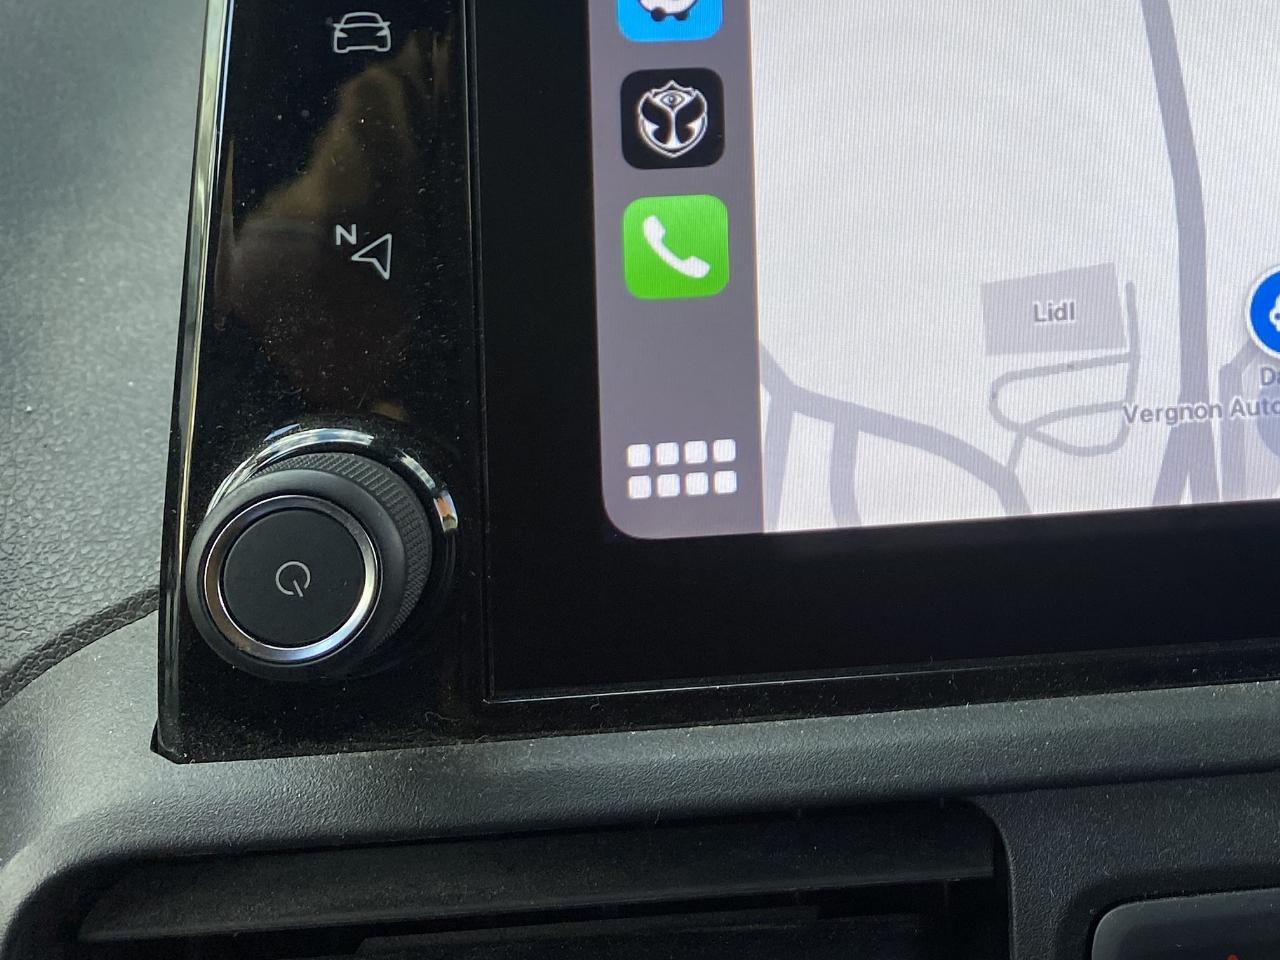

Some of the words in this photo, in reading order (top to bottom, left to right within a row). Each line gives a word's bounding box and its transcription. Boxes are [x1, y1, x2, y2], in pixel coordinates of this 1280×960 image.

[335, 223, 358, 246] N
[1033, 301, 1076, 323] Lidl
[1123, 401, 1223, 425] Vergnon
